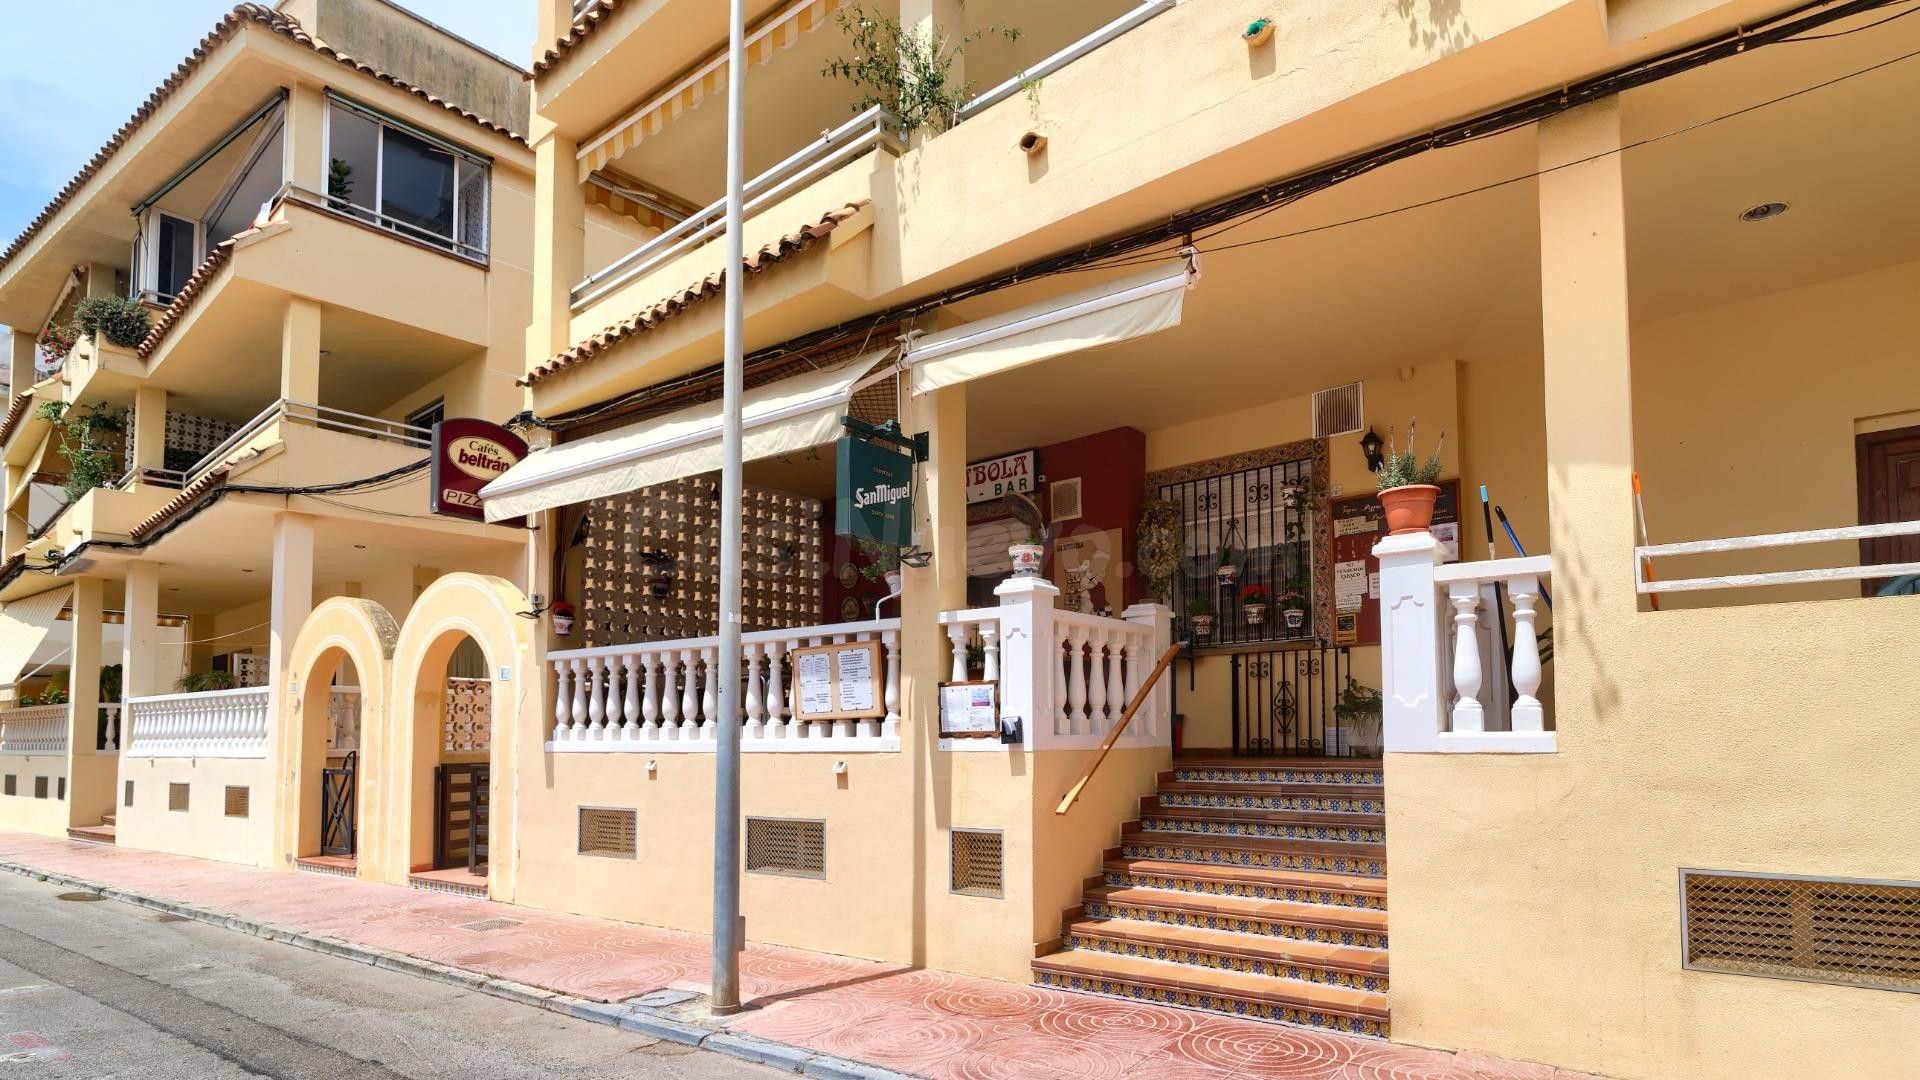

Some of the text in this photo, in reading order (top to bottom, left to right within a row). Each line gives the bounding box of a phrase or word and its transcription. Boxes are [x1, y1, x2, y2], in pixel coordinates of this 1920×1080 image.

[469, 440, 499, 456] Cafés
[458, 448, 510, 472] beltrán
[994, 477, 1028, 496] BAR
